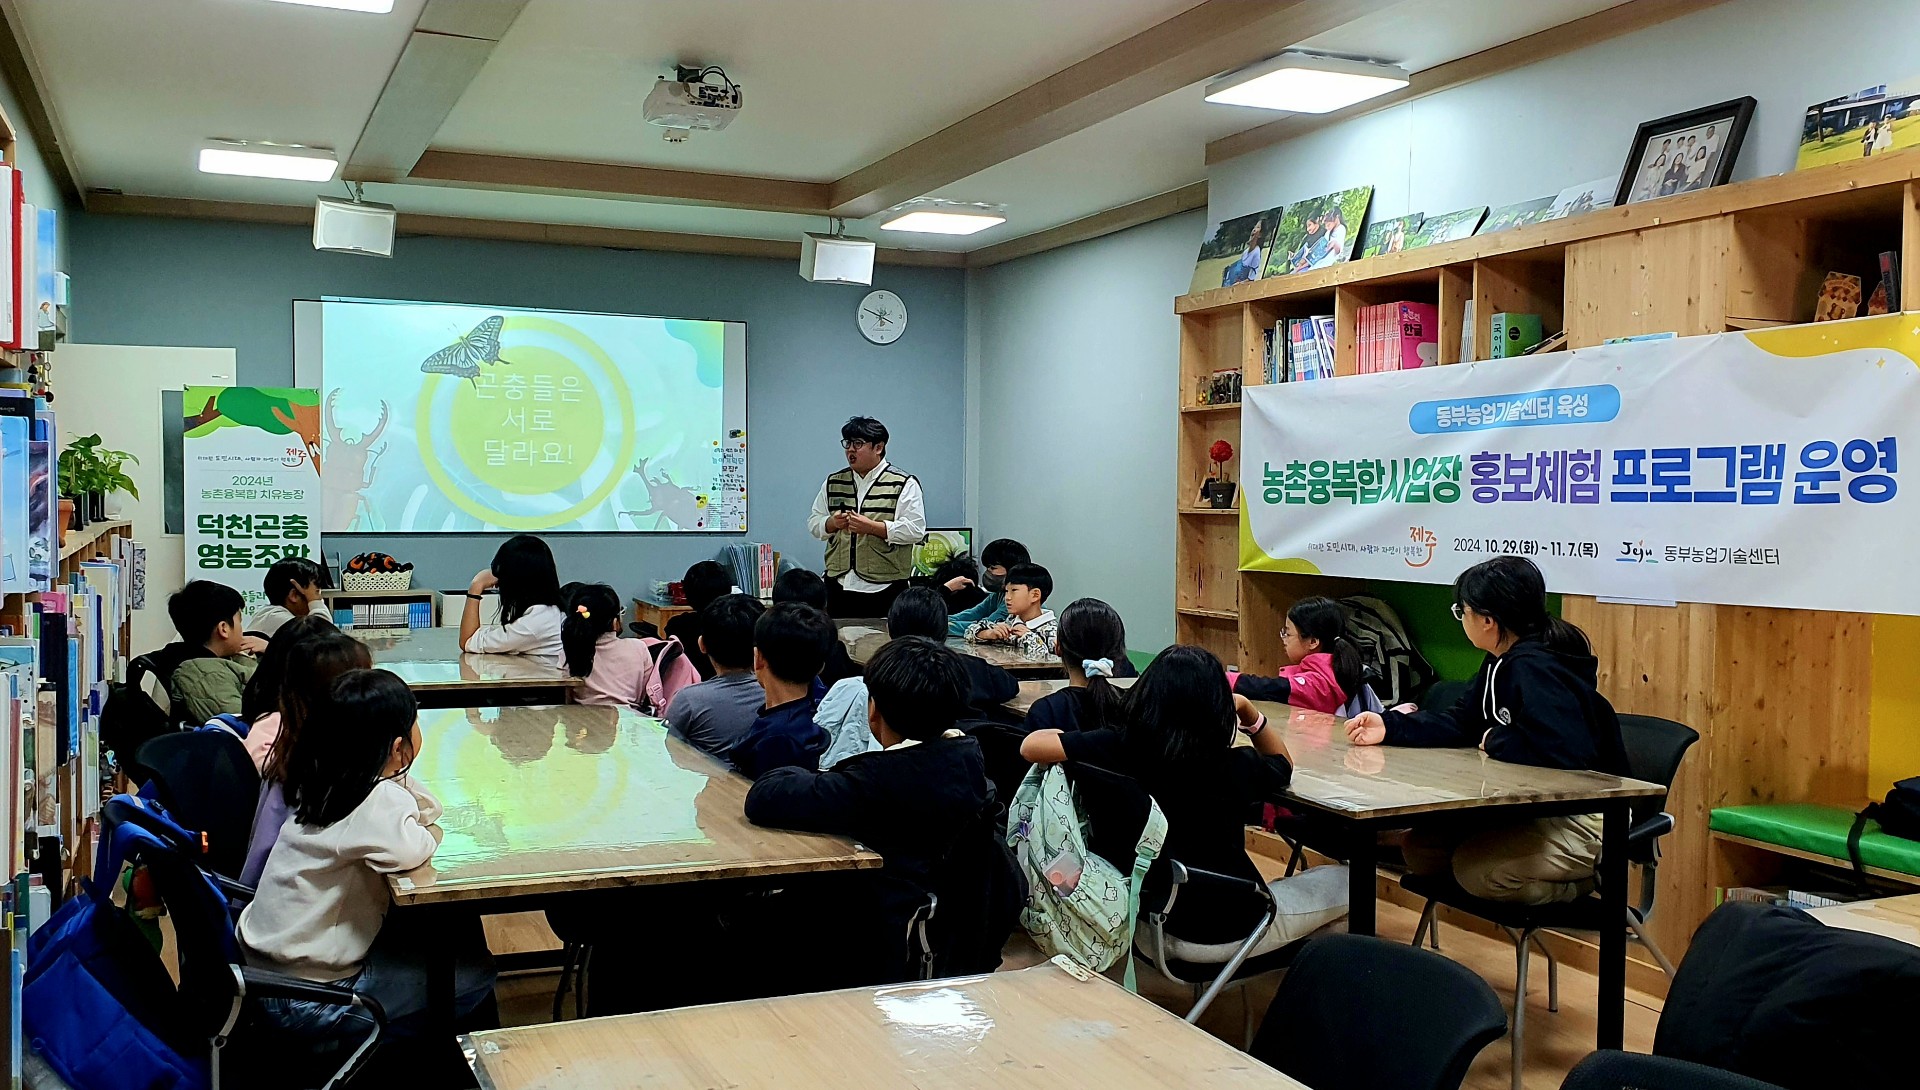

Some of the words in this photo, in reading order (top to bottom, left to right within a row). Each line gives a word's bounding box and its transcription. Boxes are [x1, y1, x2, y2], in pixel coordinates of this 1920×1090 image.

[1402, 323, 1423, 337] 한글
[476, 372, 583, 402] 곤충들은
[501, 407, 556, 433] 서로
[1436, 396, 1554, 428] 동부농업기술센터
[1558, 393, 1589, 418] 육성
[283, 447, 307, 466] 제주
[484, 439, 573, 467] 달라요!
[231, 475, 273, 486] 2024년
[1262, 455, 1462, 505] 농촌융복합사업장
[1470, 448, 1602, 504] 홍보체험
[1610, 443, 1787, 505] 프로그램
[1793, 436, 1898, 505] 운영
[201, 488, 257, 499] 농촌융복합
[260, 489, 304, 500] 치유농장
[197, 514, 309, 539] 덕천곤충
[1360, 544, 1379, 555] 사람과
[1405, 526, 1437, 565] 제주
[1453, 538, 1482, 553] 2024.
[1485, 539, 1499, 553] 10.
[1502, 540, 1539, 555] 29.(화)
[1550, 542, 1565, 556] 11.
[1568, 542, 1599, 558] 7.(목)
[1620, 540, 1653, 563] Jeju
[1664, 545, 1780, 565] 동부농업기술센터
